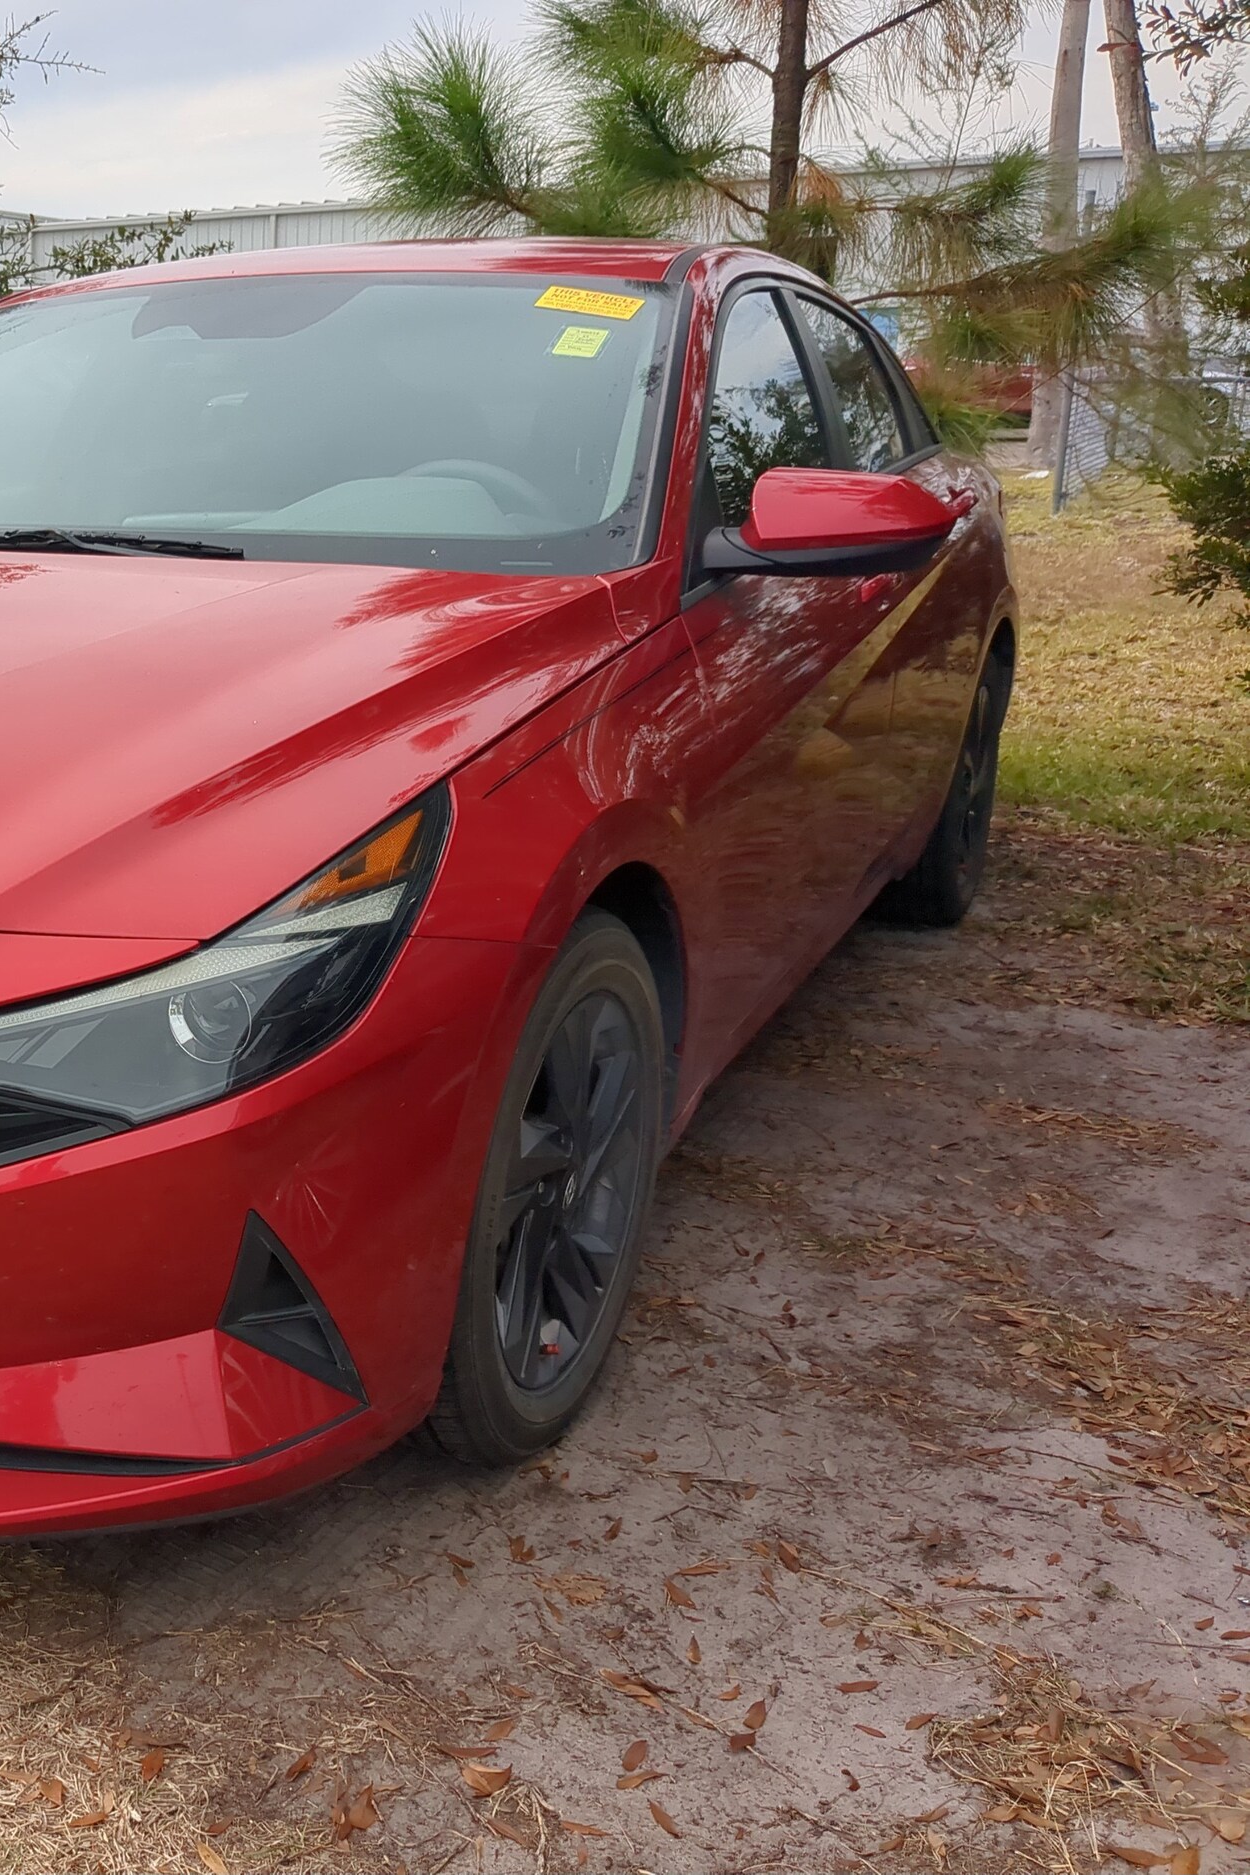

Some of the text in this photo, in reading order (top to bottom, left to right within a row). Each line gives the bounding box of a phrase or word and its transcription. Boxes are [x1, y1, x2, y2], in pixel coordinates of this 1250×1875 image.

[554, 288, 580, 296] THIS
[585, 292, 639, 306] VEHICLE
[576, 296, 600, 304] FOR
[603, 300, 631, 309] SALE
